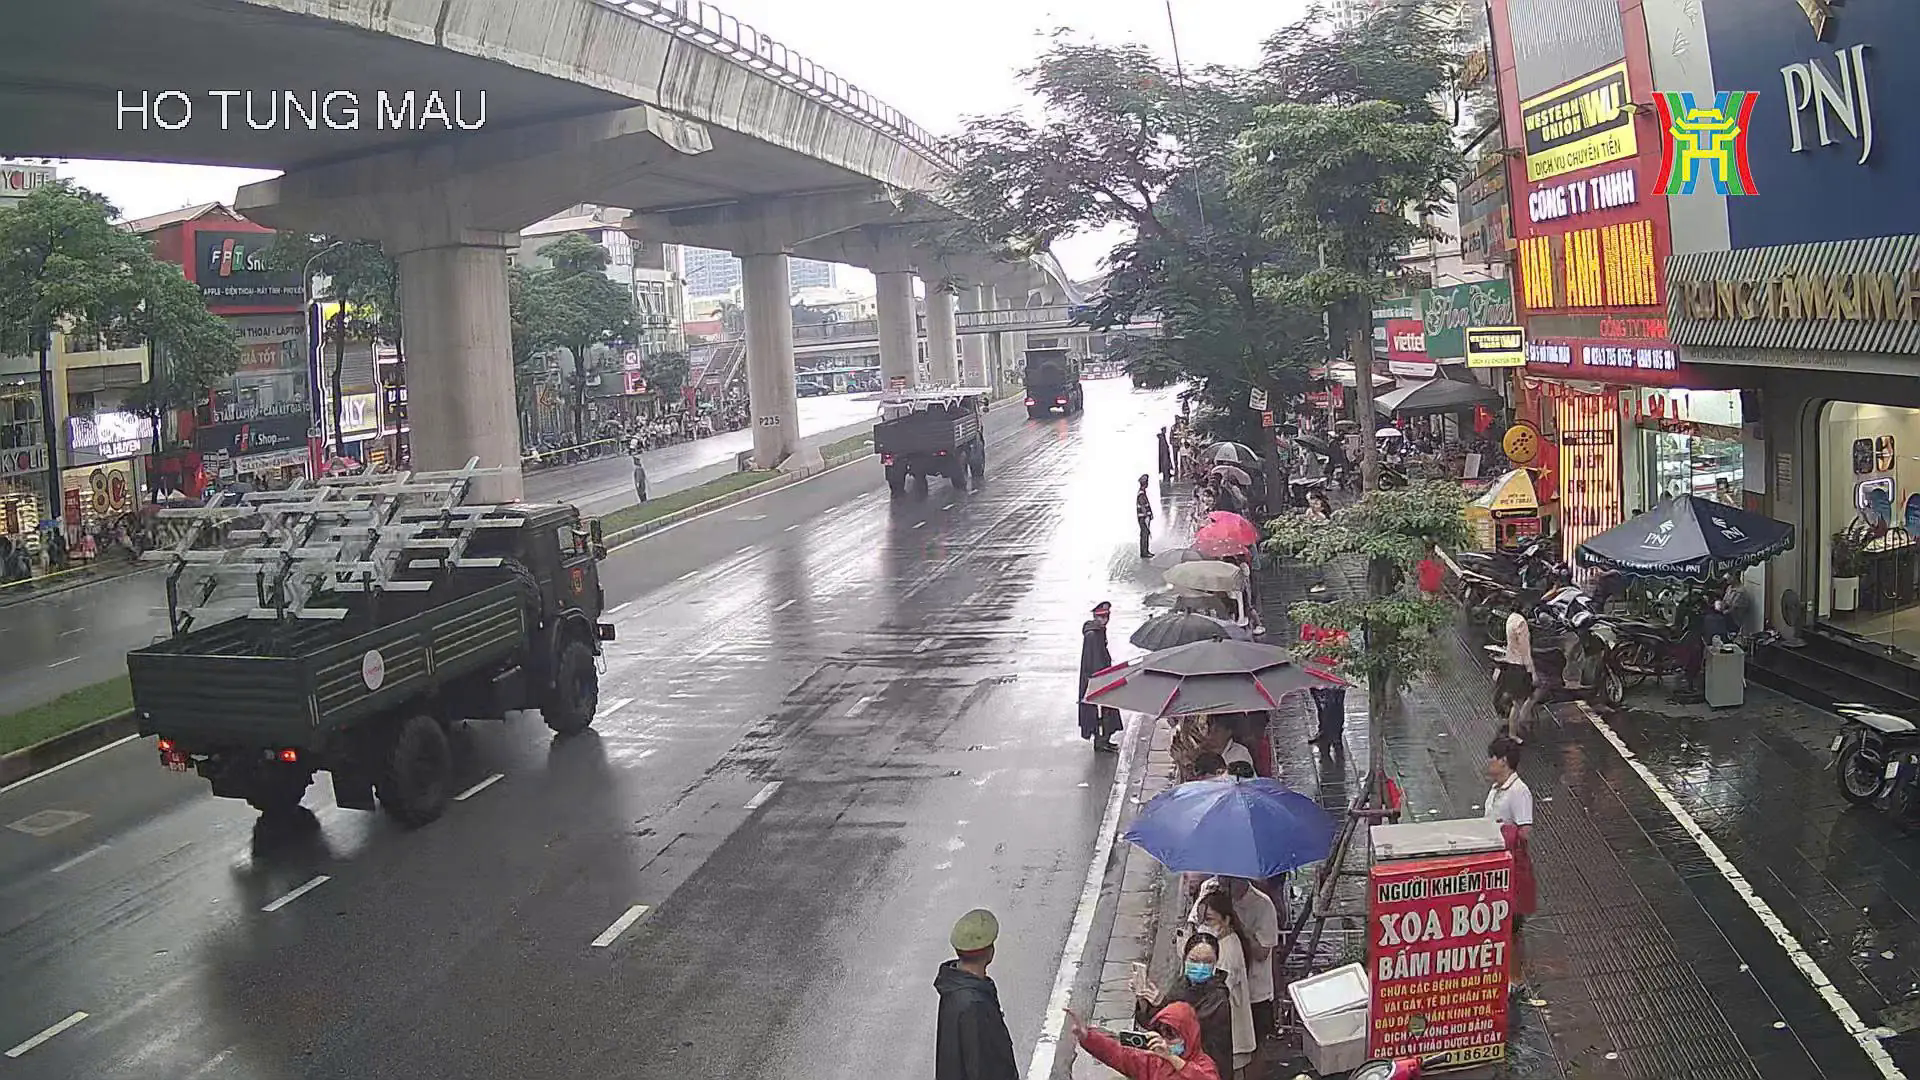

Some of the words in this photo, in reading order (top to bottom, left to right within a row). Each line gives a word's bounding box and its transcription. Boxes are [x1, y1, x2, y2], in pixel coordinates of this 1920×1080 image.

[1582, 81, 1620, 128] WU
[1780, 43, 1872, 165] PNJ
[1525, 97, 1580, 131] WESTERN
[1542, 114, 1582, 142] UNION
[1529, 184, 1568, 222] CÔNG
[1568, 181, 1587, 214] TY
[1590, 169, 1635, 210] TNHH
[203, 287, 221, 296] APPLE
[1675, 278, 1760, 320] TRUNG
[1767, 263, 1829, 320] TÂM
[1830, 271, 1898, 320] KIM
[276, 325, 305, 337] LAPTOP
[1600, 315, 1626, 337] CÔNG
[1626, 319, 1641, 337] TY
[1393, 332, 1426, 352] viettel
[260, 346, 276, 363] TỐT
[759, 415, 780, 426] P235
[257, 433, 278, 447] Shop
[1643, 532, 1672, 548] PNJ
[1720, 526, 1746, 542] PNJ
[1378, 876, 1428, 903] NGƯỜI
[1431, 868, 1482, 897] KHIẾM
[1485, 868, 1510, 892] THỊ
[1379, 908, 1444, 946] XOA
[1451, 893, 1509, 937] BÓP
[1379, 946, 1431, 980] BẤM
[1436, 938, 1505, 974] HUYỆT
[1409, 982, 1430, 994] CÁC
[1432, 978, 1459, 992] BỆNH
[1384, 1000, 1401, 1013] VAI
[1427, 995, 1438, 1008] TÊ
[1446, 1006, 1472, 1021] KINH
[1384, 1030, 1408, 1044] DỊCH
[1444, 1035, 1470, 1051] DƯỢC
[1471, 1032, 1482, 1045] LÁ
